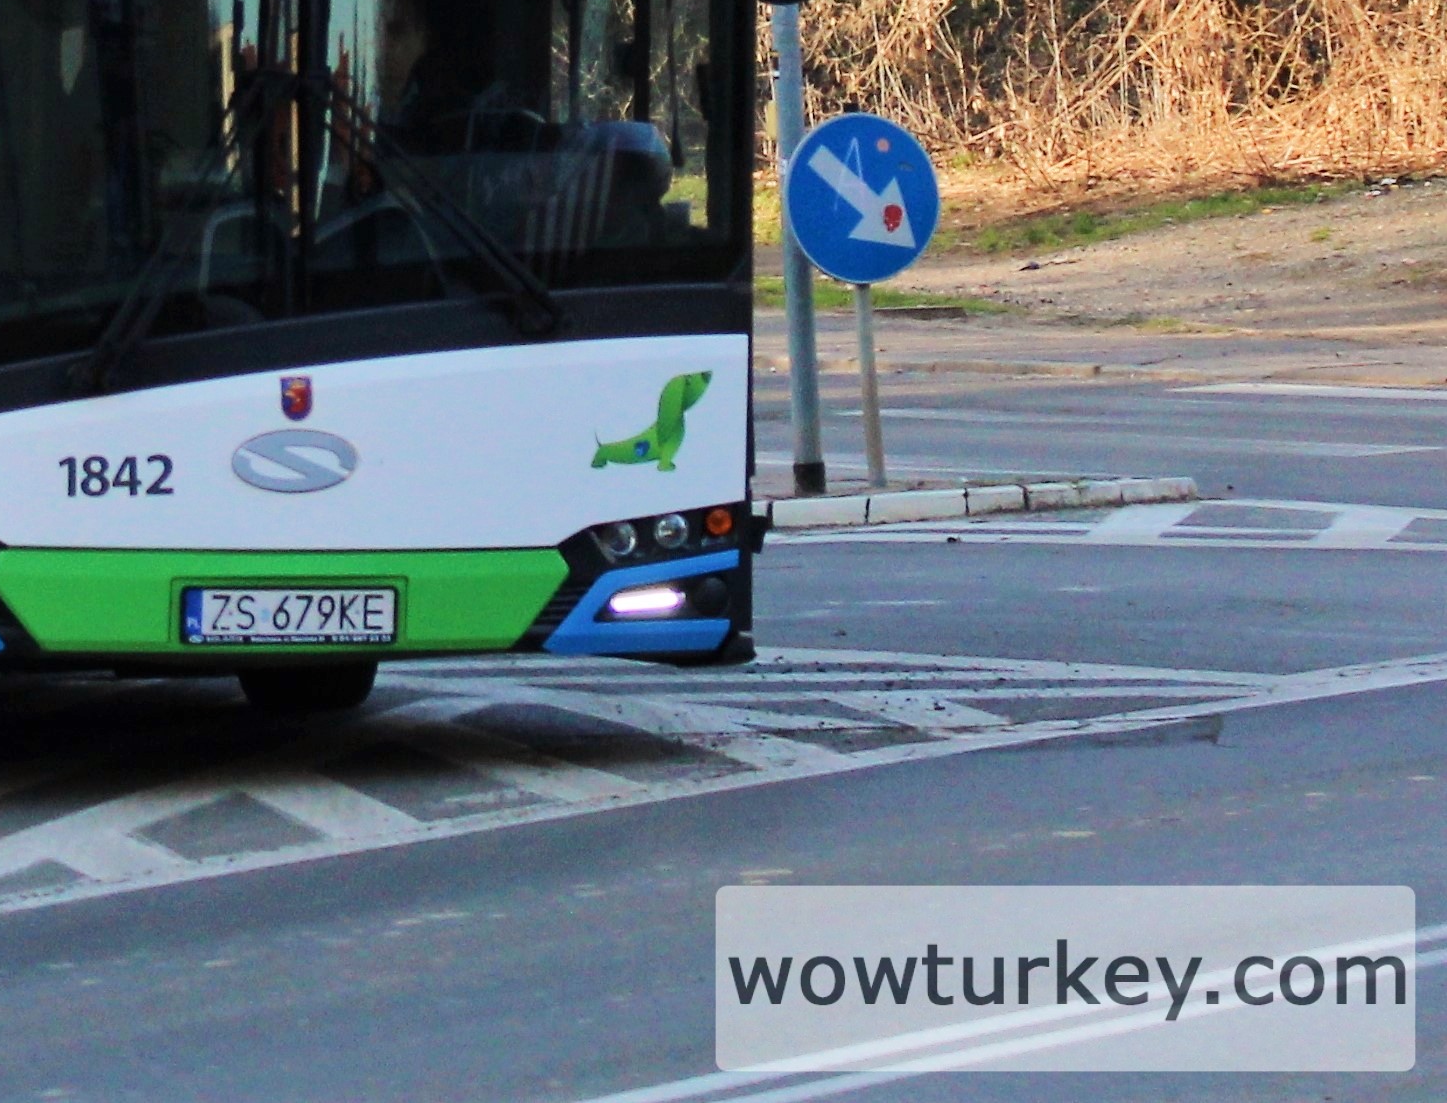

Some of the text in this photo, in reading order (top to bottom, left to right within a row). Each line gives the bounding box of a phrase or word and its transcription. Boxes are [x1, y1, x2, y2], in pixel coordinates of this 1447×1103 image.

[58, 454, 174, 497] 1842
[212, 595, 384, 630] ZS 679KE
